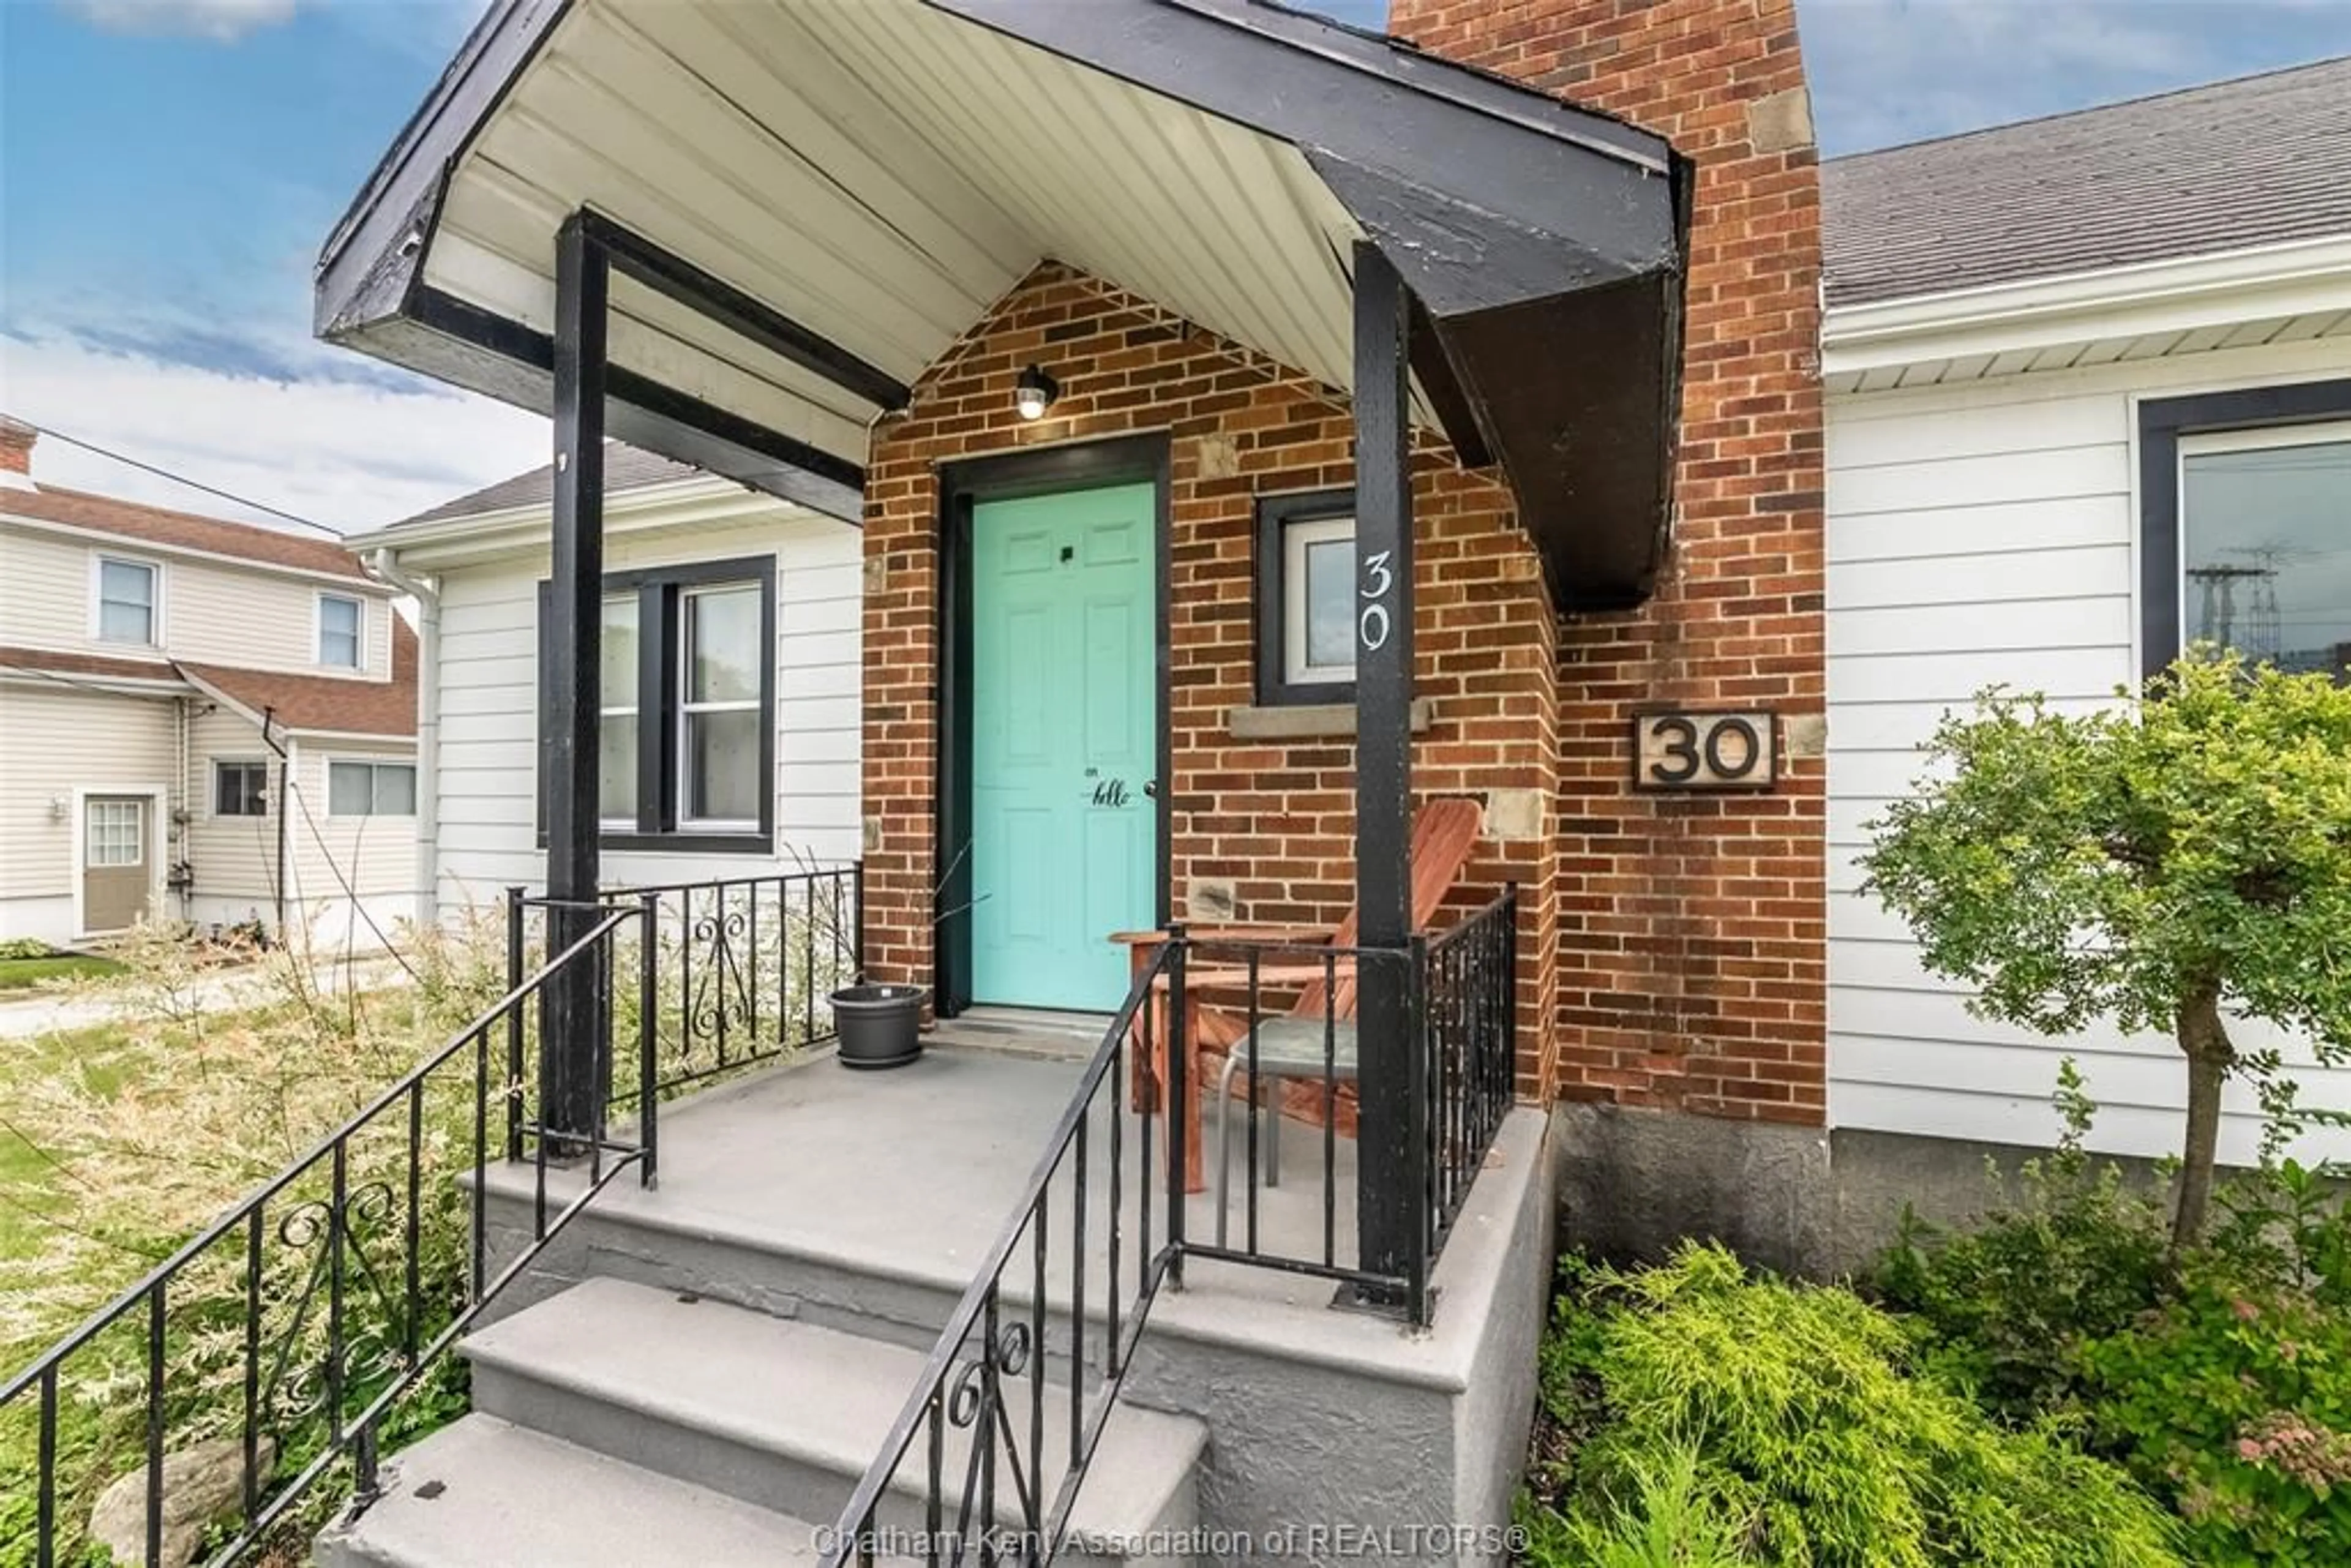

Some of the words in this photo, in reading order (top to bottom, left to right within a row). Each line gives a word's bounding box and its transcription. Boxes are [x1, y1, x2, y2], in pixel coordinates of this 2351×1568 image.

[1360, 550, 1392, 650] 30
[1651, 718, 1760, 781] 30
[1092, 778, 1131, 807] hello
